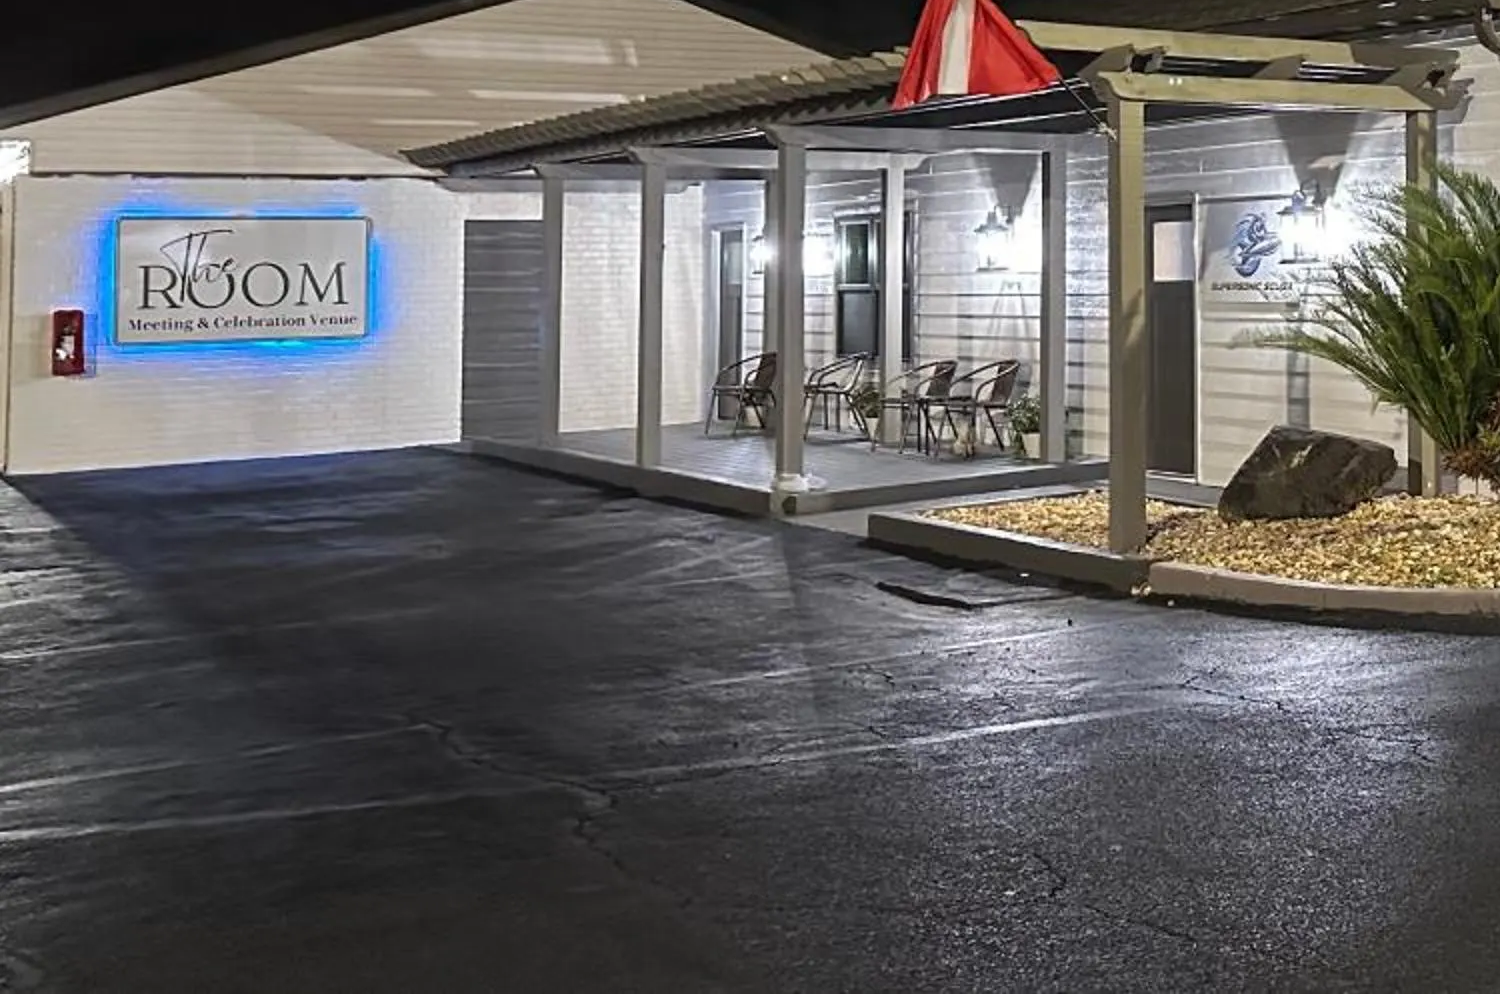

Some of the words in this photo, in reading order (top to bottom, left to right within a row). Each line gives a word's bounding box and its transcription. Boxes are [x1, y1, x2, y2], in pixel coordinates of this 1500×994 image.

[138, 261, 349, 309] ROOM
[160, 229, 235, 303] The
[127, 318, 193, 332] Meeting
[197, 316, 210, 330] &
[213, 314, 306, 329] Celebration
[308, 312, 359, 326] Venue
